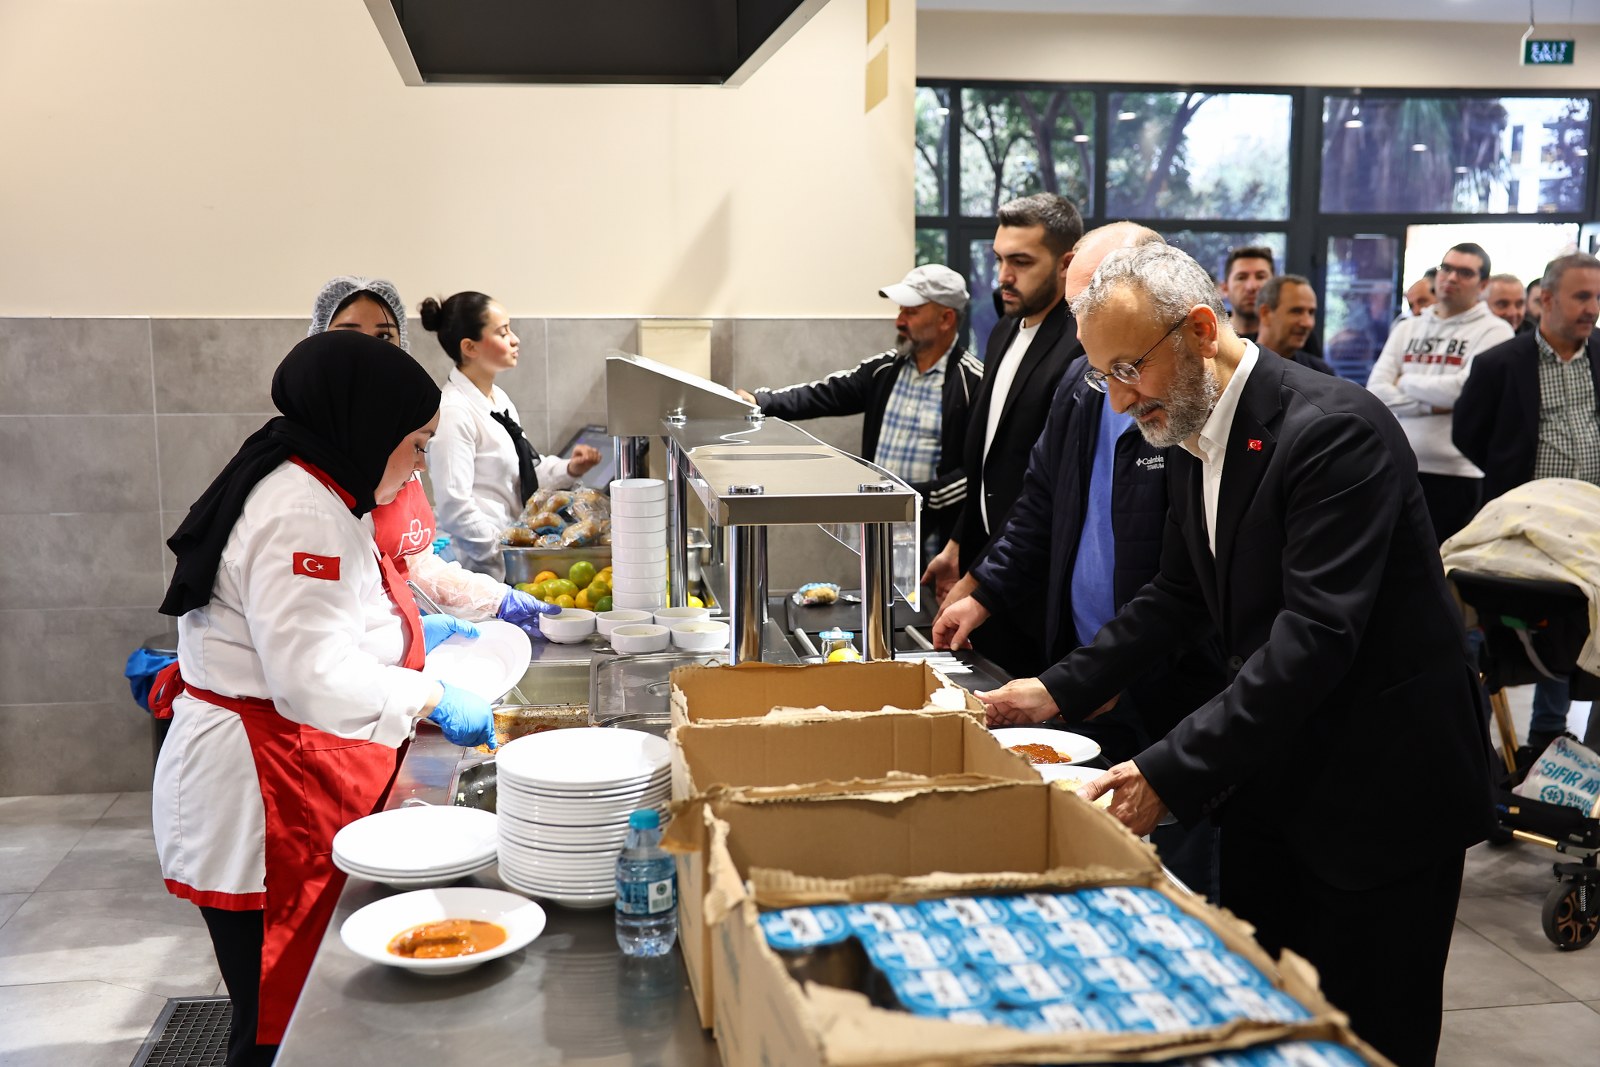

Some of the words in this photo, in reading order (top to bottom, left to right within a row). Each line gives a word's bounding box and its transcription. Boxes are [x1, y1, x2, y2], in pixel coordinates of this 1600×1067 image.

[1531, 41, 1567, 52] EXIT
[1405, 338, 1444, 354] JUST
[1446, 339, 1468, 356] BE
